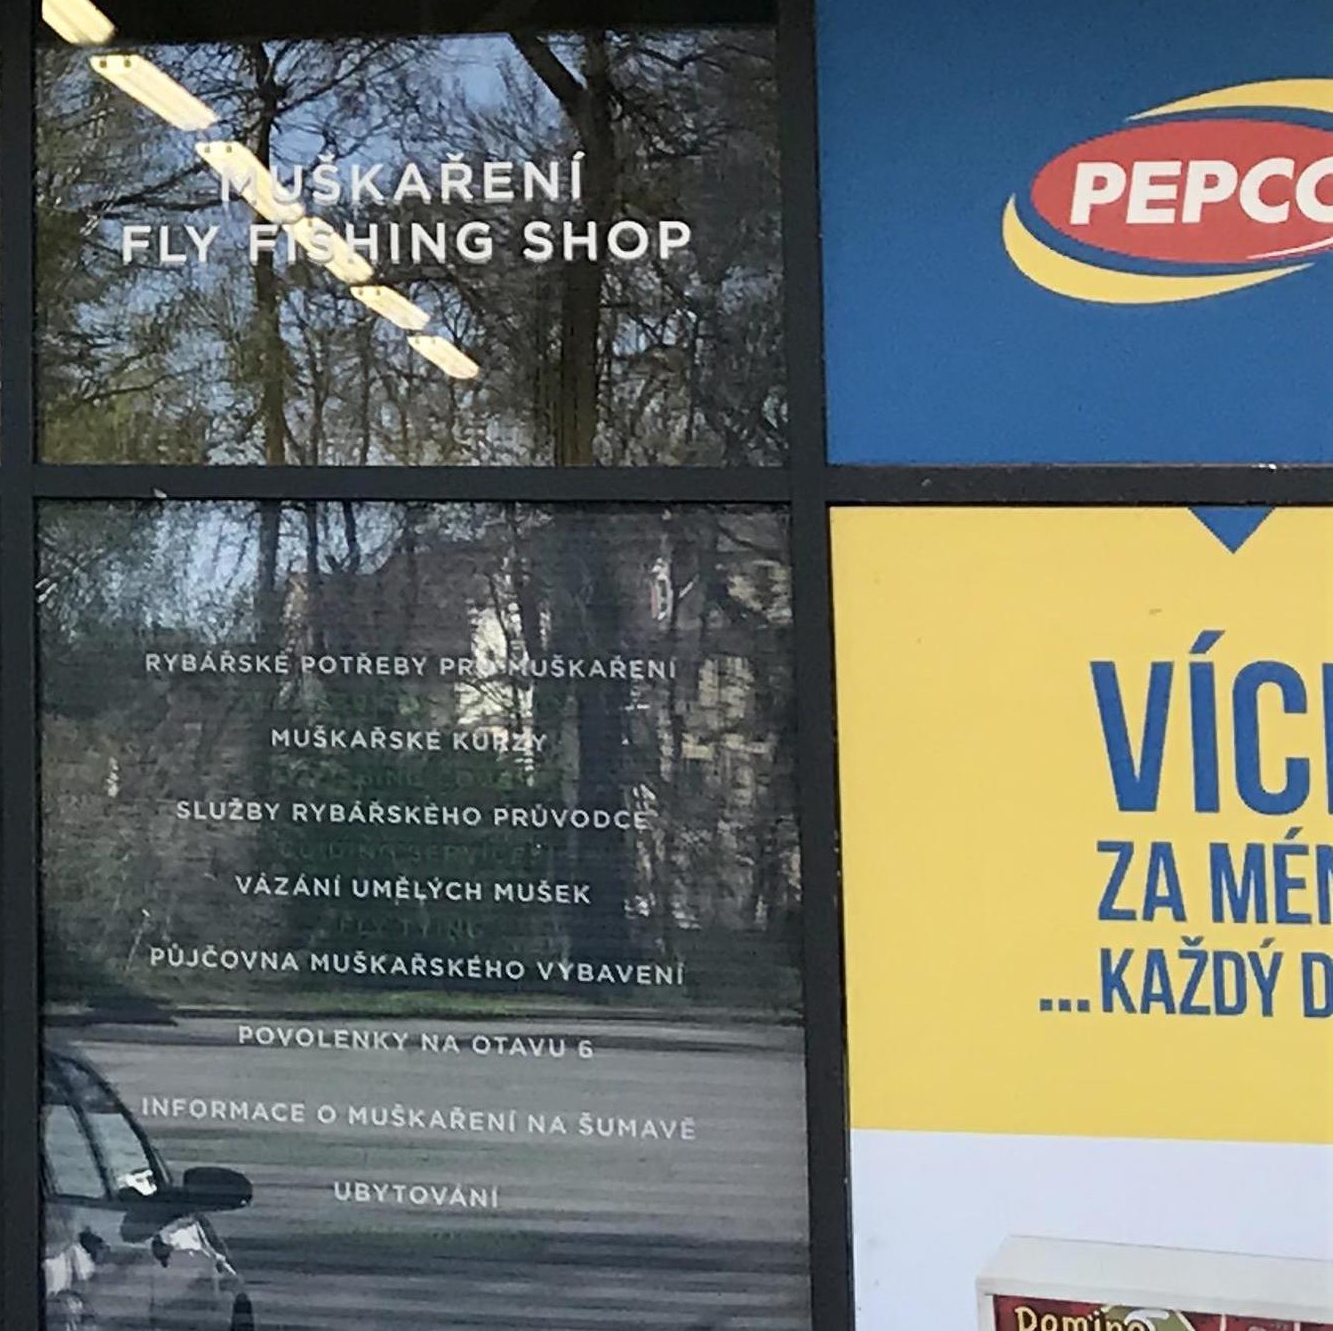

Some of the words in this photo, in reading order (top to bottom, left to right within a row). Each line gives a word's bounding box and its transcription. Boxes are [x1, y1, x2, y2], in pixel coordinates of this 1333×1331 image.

[220, 151, 585, 205] MUŠKAŘENÍ
[121, 223, 221, 266] FLY
[248, 221, 494, 266] FISHING
[522, 220, 692, 263] SHOP
[144, 649, 290, 675] RYBÁŘSKÉ
[300, 652, 428, 676] POTŘEBY
[452, 730, 547, 752] KURZY
[1089, 629, 1333, 816] VÍC
[176, 797, 280, 821] SLUŽBY
[292, 800, 482, 827] RYBÁŘSKÉHO
[493, 803, 649, 830] PRŮVODCE
[235, 872, 342, 897] VÁZÁNÍ
[351, 875, 483, 901] UMĚLÝCH
[494, 879, 591, 905] MUŠEK
[1096, 840, 1188, 923] ZA
[149, 942, 300, 971] PŮJČOVNA
[310, 950, 525, 981] MUŠKAŘSKÉHO
[536, 961, 684, 986] VYBAVENÍ
[238, 1024, 409, 1051] POVOLENKY
[420, 1034, 461, 1054] NA
[472, 1035, 566, 1058] OTAVU
[578, 1039, 594, 1059] 6
[141, 1097, 306, 1123] INFORMACE
[316, 1104, 337, 1125] O
[348, 1103, 517, 1133] MUŠKAŘENÍ
[527, 1114, 567, 1135] NA
[578, 1111, 697, 1140] ŠUMAVĚ
[333, 1180, 499, 1208] UBYTOVÁNÍ
